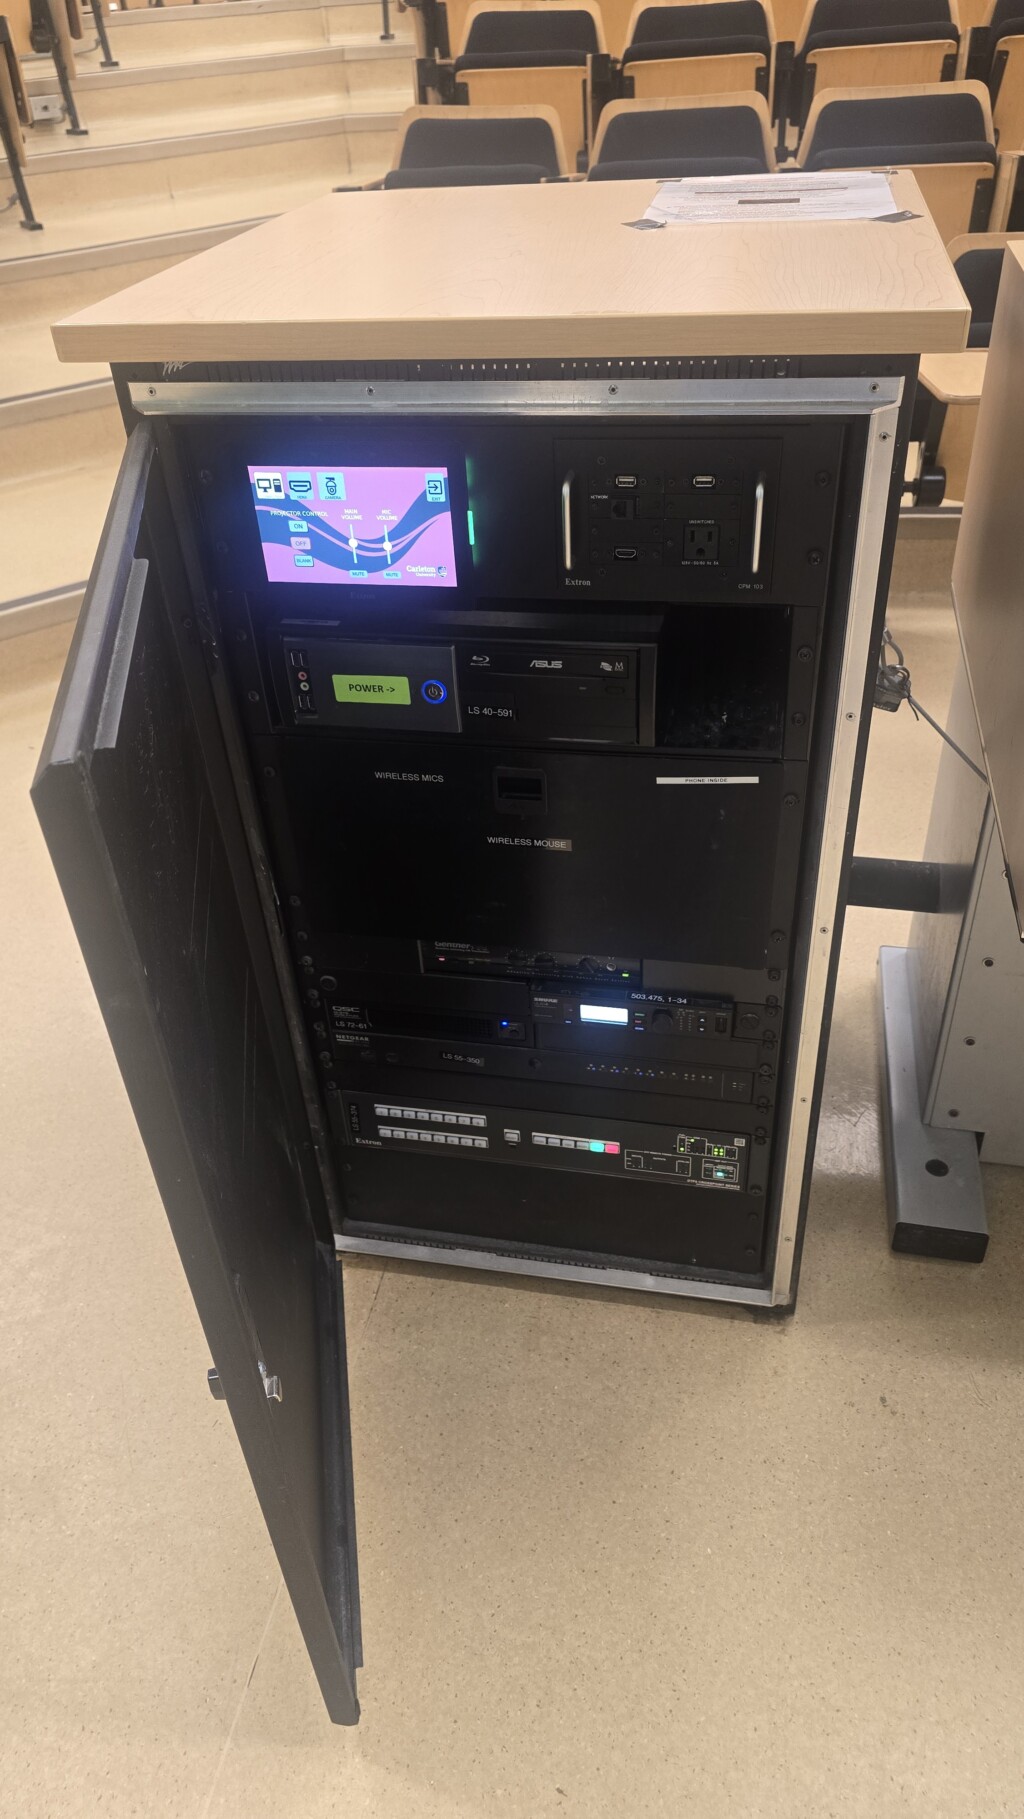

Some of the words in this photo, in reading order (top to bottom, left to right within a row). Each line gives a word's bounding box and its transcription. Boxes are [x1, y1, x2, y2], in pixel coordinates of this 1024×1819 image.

[270, 510, 301, 518] PROJECTOR
[405, 565, 436, 573] Carleton
[565, 577, 591, 587] Extron
[529, 659, 563, 669] ASUS
[348, 683, 384, 693] POWER
[468, 705, 480, 715] LS
[482, 707, 513, 718] 40-591
[374, 771, 420, 783] WIRELESS
[421, 773, 444, 783] MICS
[486, 836, 532, 847] WIRELESS
[533, 839, 567, 849] MOUSE
[667, 996, 688, 1005] 1-34
[332, 1005, 361, 1013] QSC
[335, 1034, 369, 1042] NETGEAR
[442, 1052, 454, 1060] LS
[355, 1137, 383, 1146] Extron
